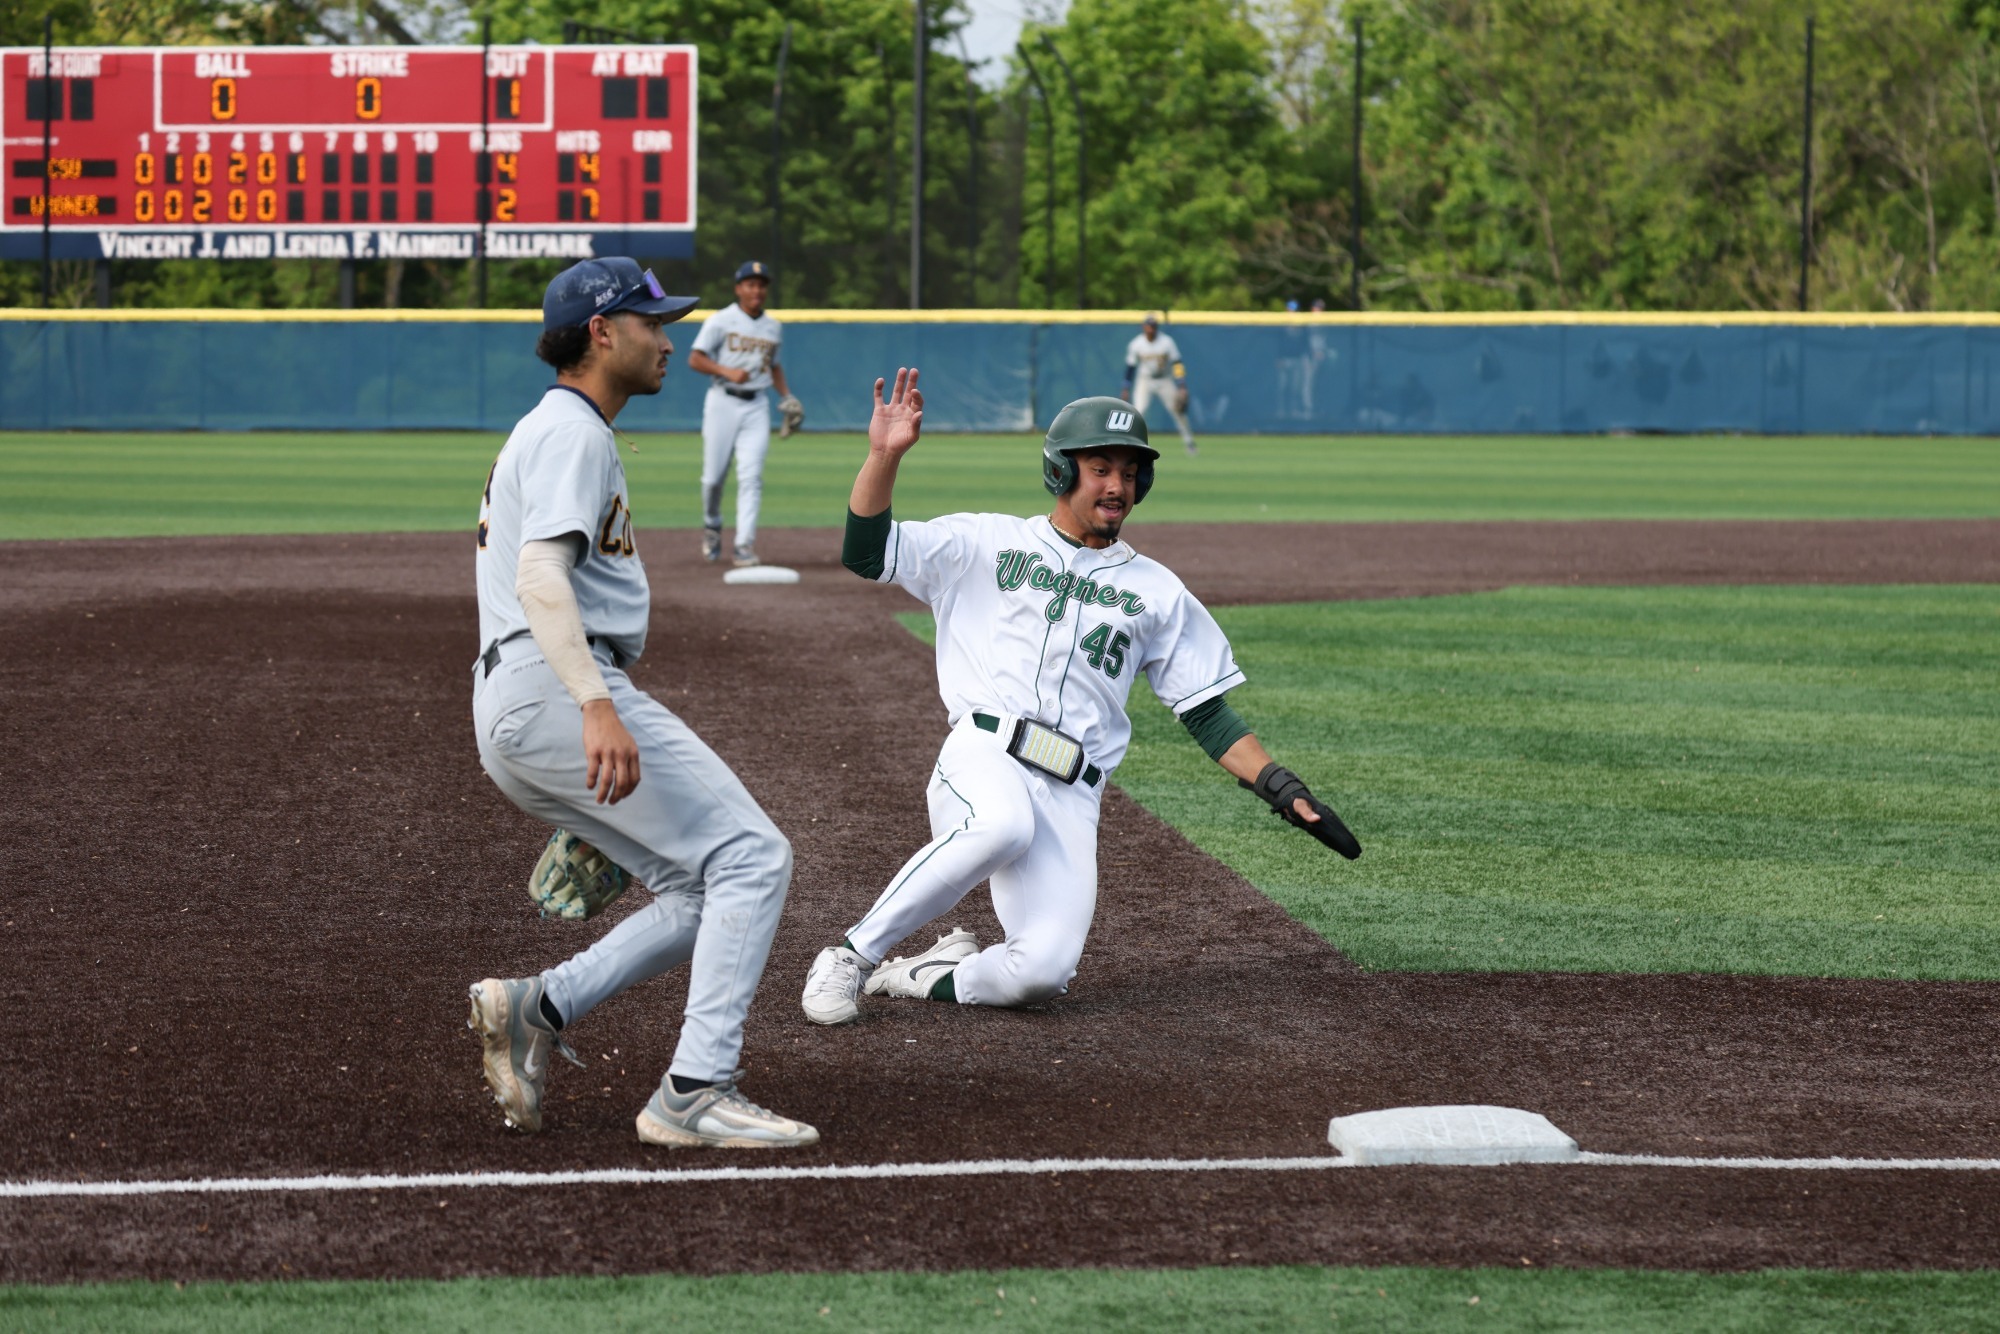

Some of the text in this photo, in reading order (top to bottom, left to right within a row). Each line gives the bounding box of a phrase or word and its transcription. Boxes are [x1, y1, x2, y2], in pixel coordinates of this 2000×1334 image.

[195, 54, 251, 77] BALL
[329, 53, 409, 77] STRIKE
[487, 54, 530, 77] OUT
[592, 54, 667, 75] AT BAT
[212, 77, 236, 119] 0
[356, 77, 381, 119] 0
[511, 80, 520, 115] 1
[138, 132, 150, 152] 1
[165, 132, 180, 152] 2
[196, 132, 210, 152] 3
[230, 132, 245, 152] 4
[259, 132, 274, 152] 5
[288, 132, 303, 152] 6
[324, 132, 338, 152] 7
[382, 132, 397, 152] 9
[412, 132, 438, 152] 10
[556, 131, 600, 152] HITS
[135, 151, 306, 184] 0 1 0 2 0 1
[497, 152, 517, 178] 4
[579, 152, 599, 180] 4
[136, 189, 277, 221] 0 0 2 0 0
[497, 188, 517, 221] 2
[582, 188, 599, 216] 7
[99, 233, 194, 257] VINCENT
[198, 233, 219, 257] J.
[223, 235, 271, 257] AND
[353, 233, 374, 258] F.
[485, 233, 593, 257] BALLPARK
[1106, 410, 1134, 432] W
[996, 549, 1145, 624] Wagner
[1080, 622, 1131, 679] 45
